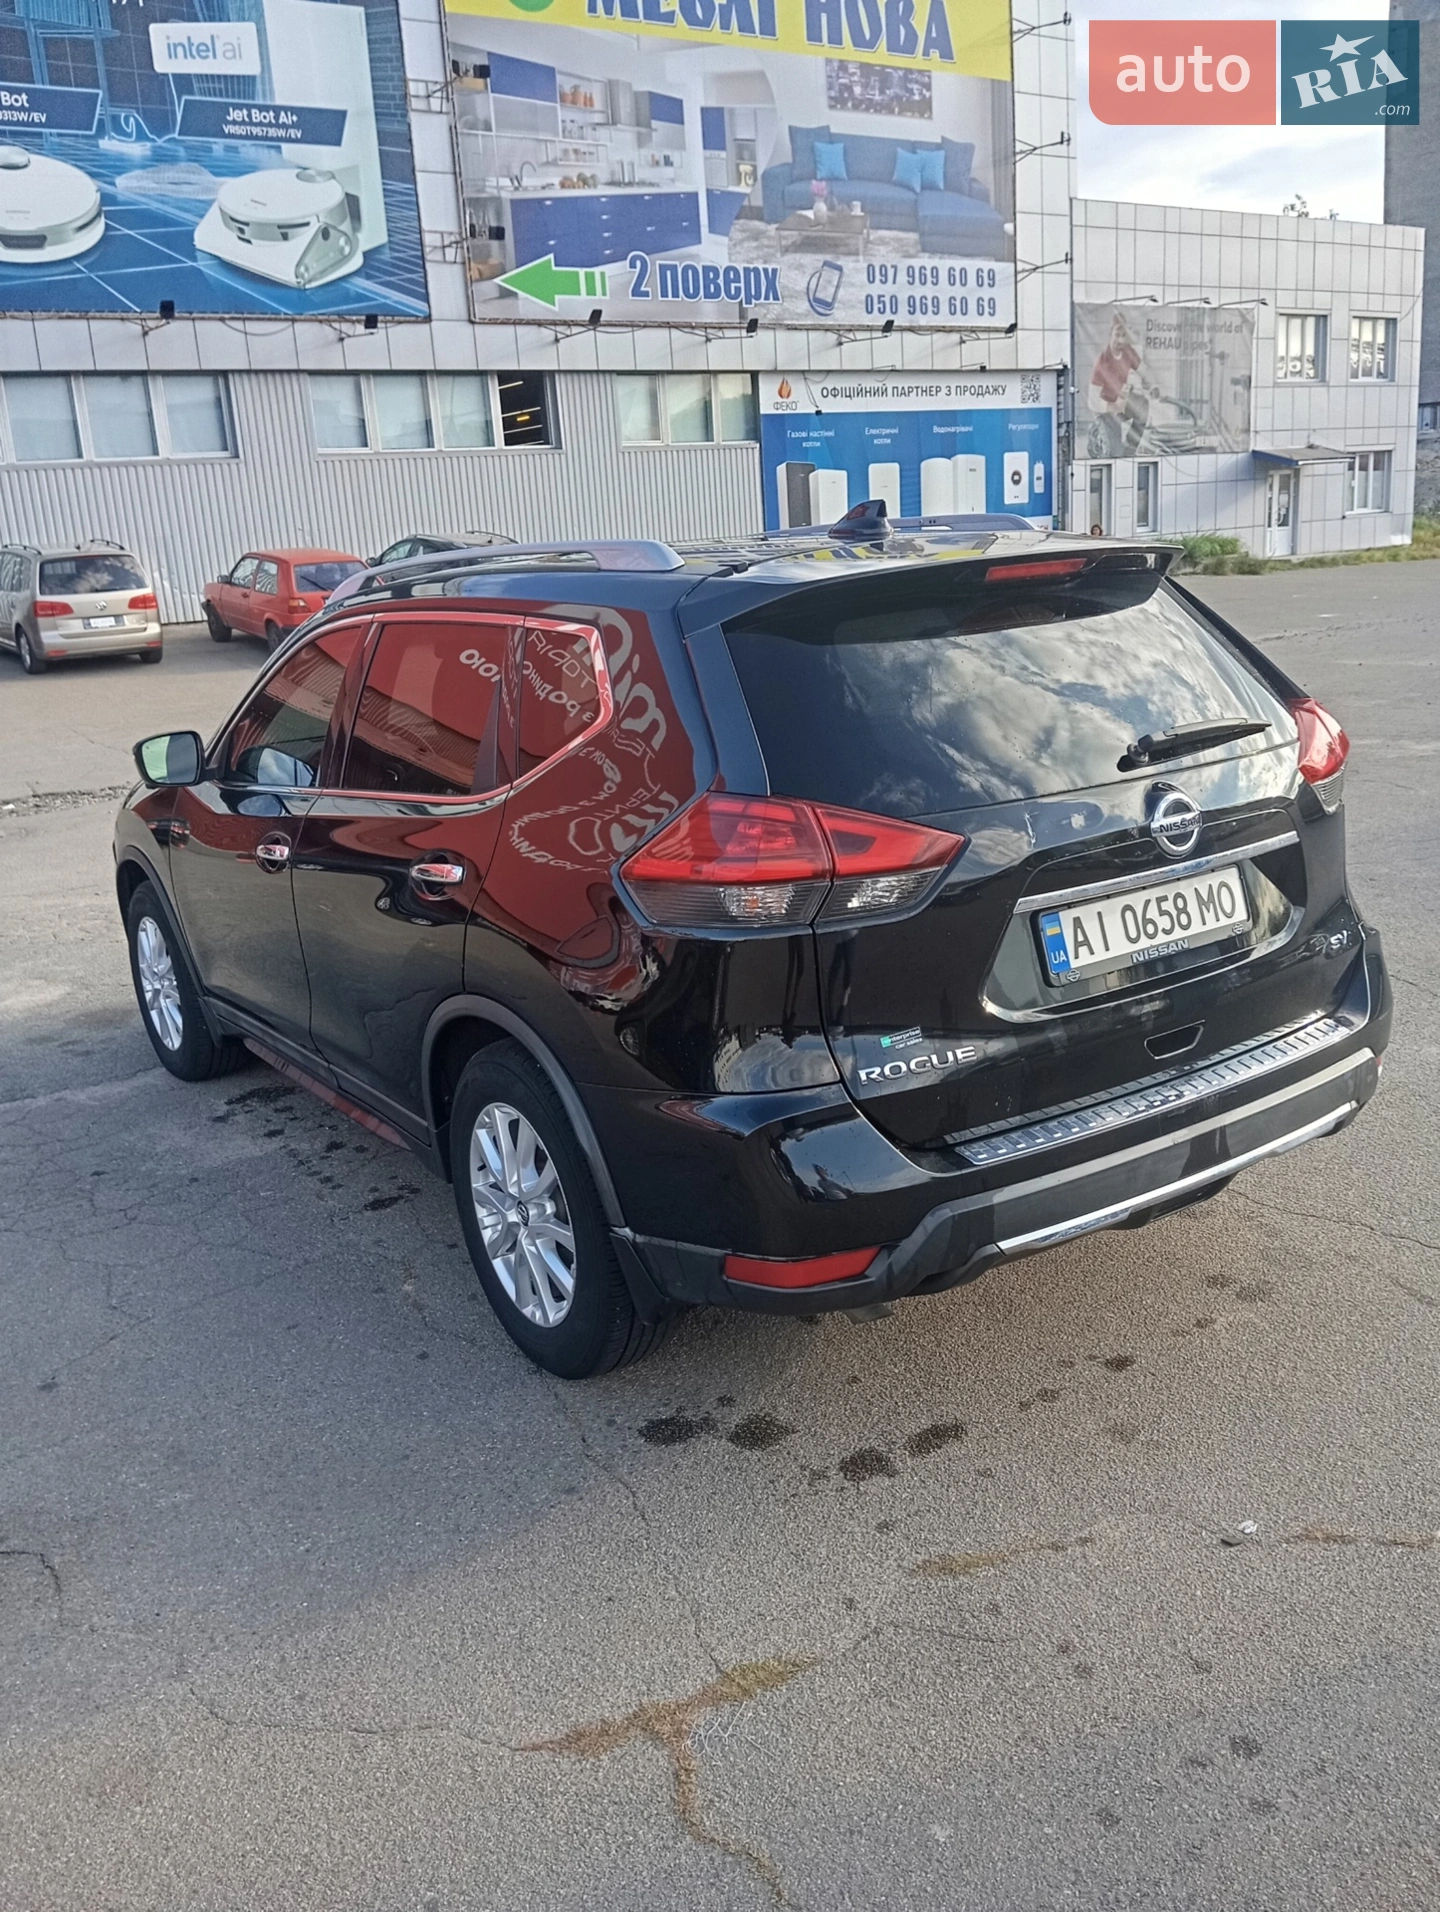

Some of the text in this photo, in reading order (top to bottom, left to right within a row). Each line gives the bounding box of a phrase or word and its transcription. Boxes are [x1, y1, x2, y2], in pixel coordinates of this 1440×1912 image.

[804, 0, 956, 63] НОВА
[166, 34, 244, 61] intel ai
[0, 90, 30, 108] Bot
[226, 107, 249, 122] Jet
[251, 109, 276, 123] Bot
[627, 251, 783, 307] 2 поверх
[866, 263, 996, 288] 097 969 60 69
[865, 293, 996, 317] 050 969 60 69
[1145, 335, 1181, 350] REHAU
[820, 383, 888, 401] ОФІЦІЙНИЙ
[892, 384, 942, 399] ПАРТНЕР
[955, 384, 1008, 399] ПРОДАЖУ
[773, 400, 798, 412] ФЕКО
[787, 430, 808, 439] Газові
[1159, 815, 1200, 833] NISSAN
[1072, 879, 1237, 960] AI 0658 MO
[1051, 949, 1068, 964] UA
[1131, 938, 1190, 964] NISSAN
[858, 1045, 978, 1086] ROGUE
